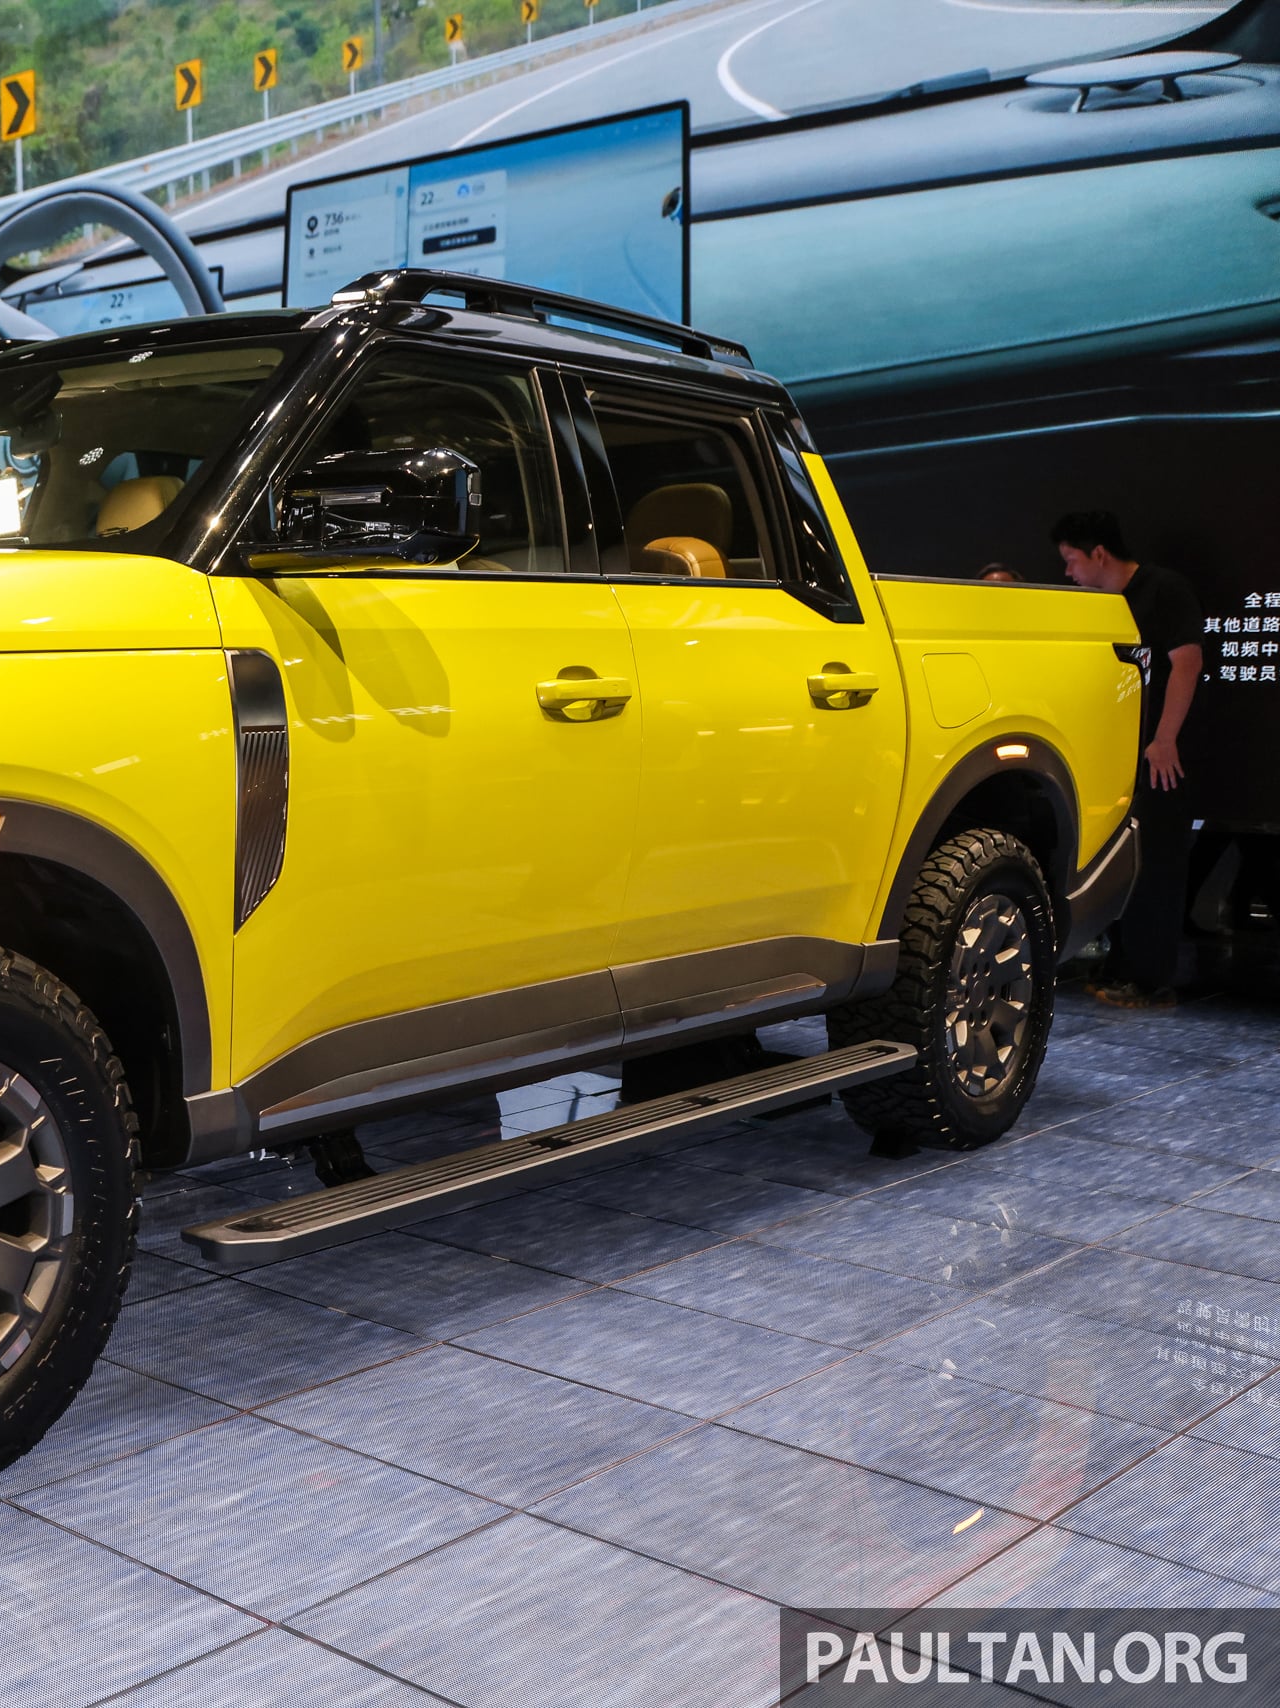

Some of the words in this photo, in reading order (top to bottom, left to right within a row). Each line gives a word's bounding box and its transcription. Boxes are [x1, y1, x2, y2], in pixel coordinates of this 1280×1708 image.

[421, 191, 434, 206] 22
[324, 212, 344, 227] 736
[110, 293, 125, 309] 22
